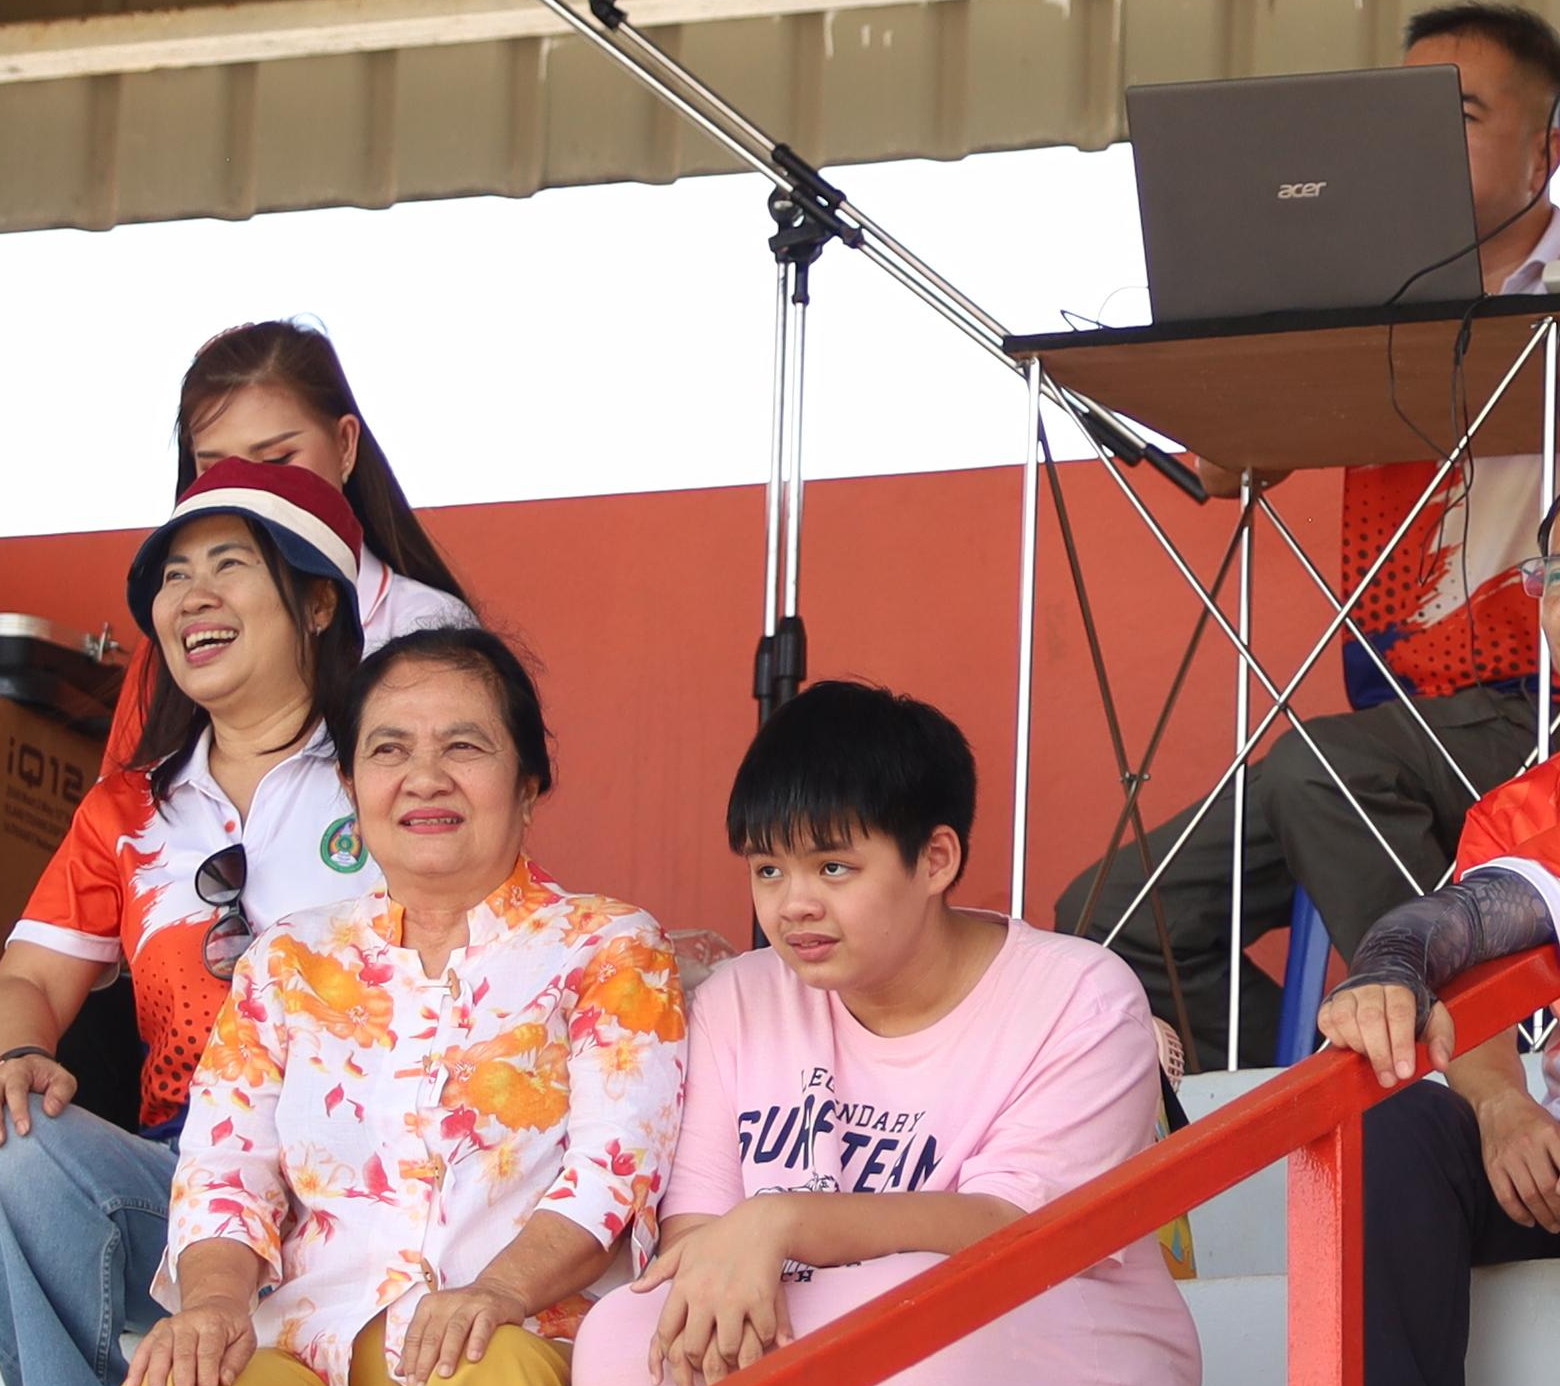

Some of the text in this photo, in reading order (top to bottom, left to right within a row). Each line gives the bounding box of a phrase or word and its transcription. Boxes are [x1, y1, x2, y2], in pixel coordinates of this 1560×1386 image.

[1278, 182, 1327, 198] acer
[6, 737, 85, 803] iQ12
[738, 1094, 835, 1170] SURF
